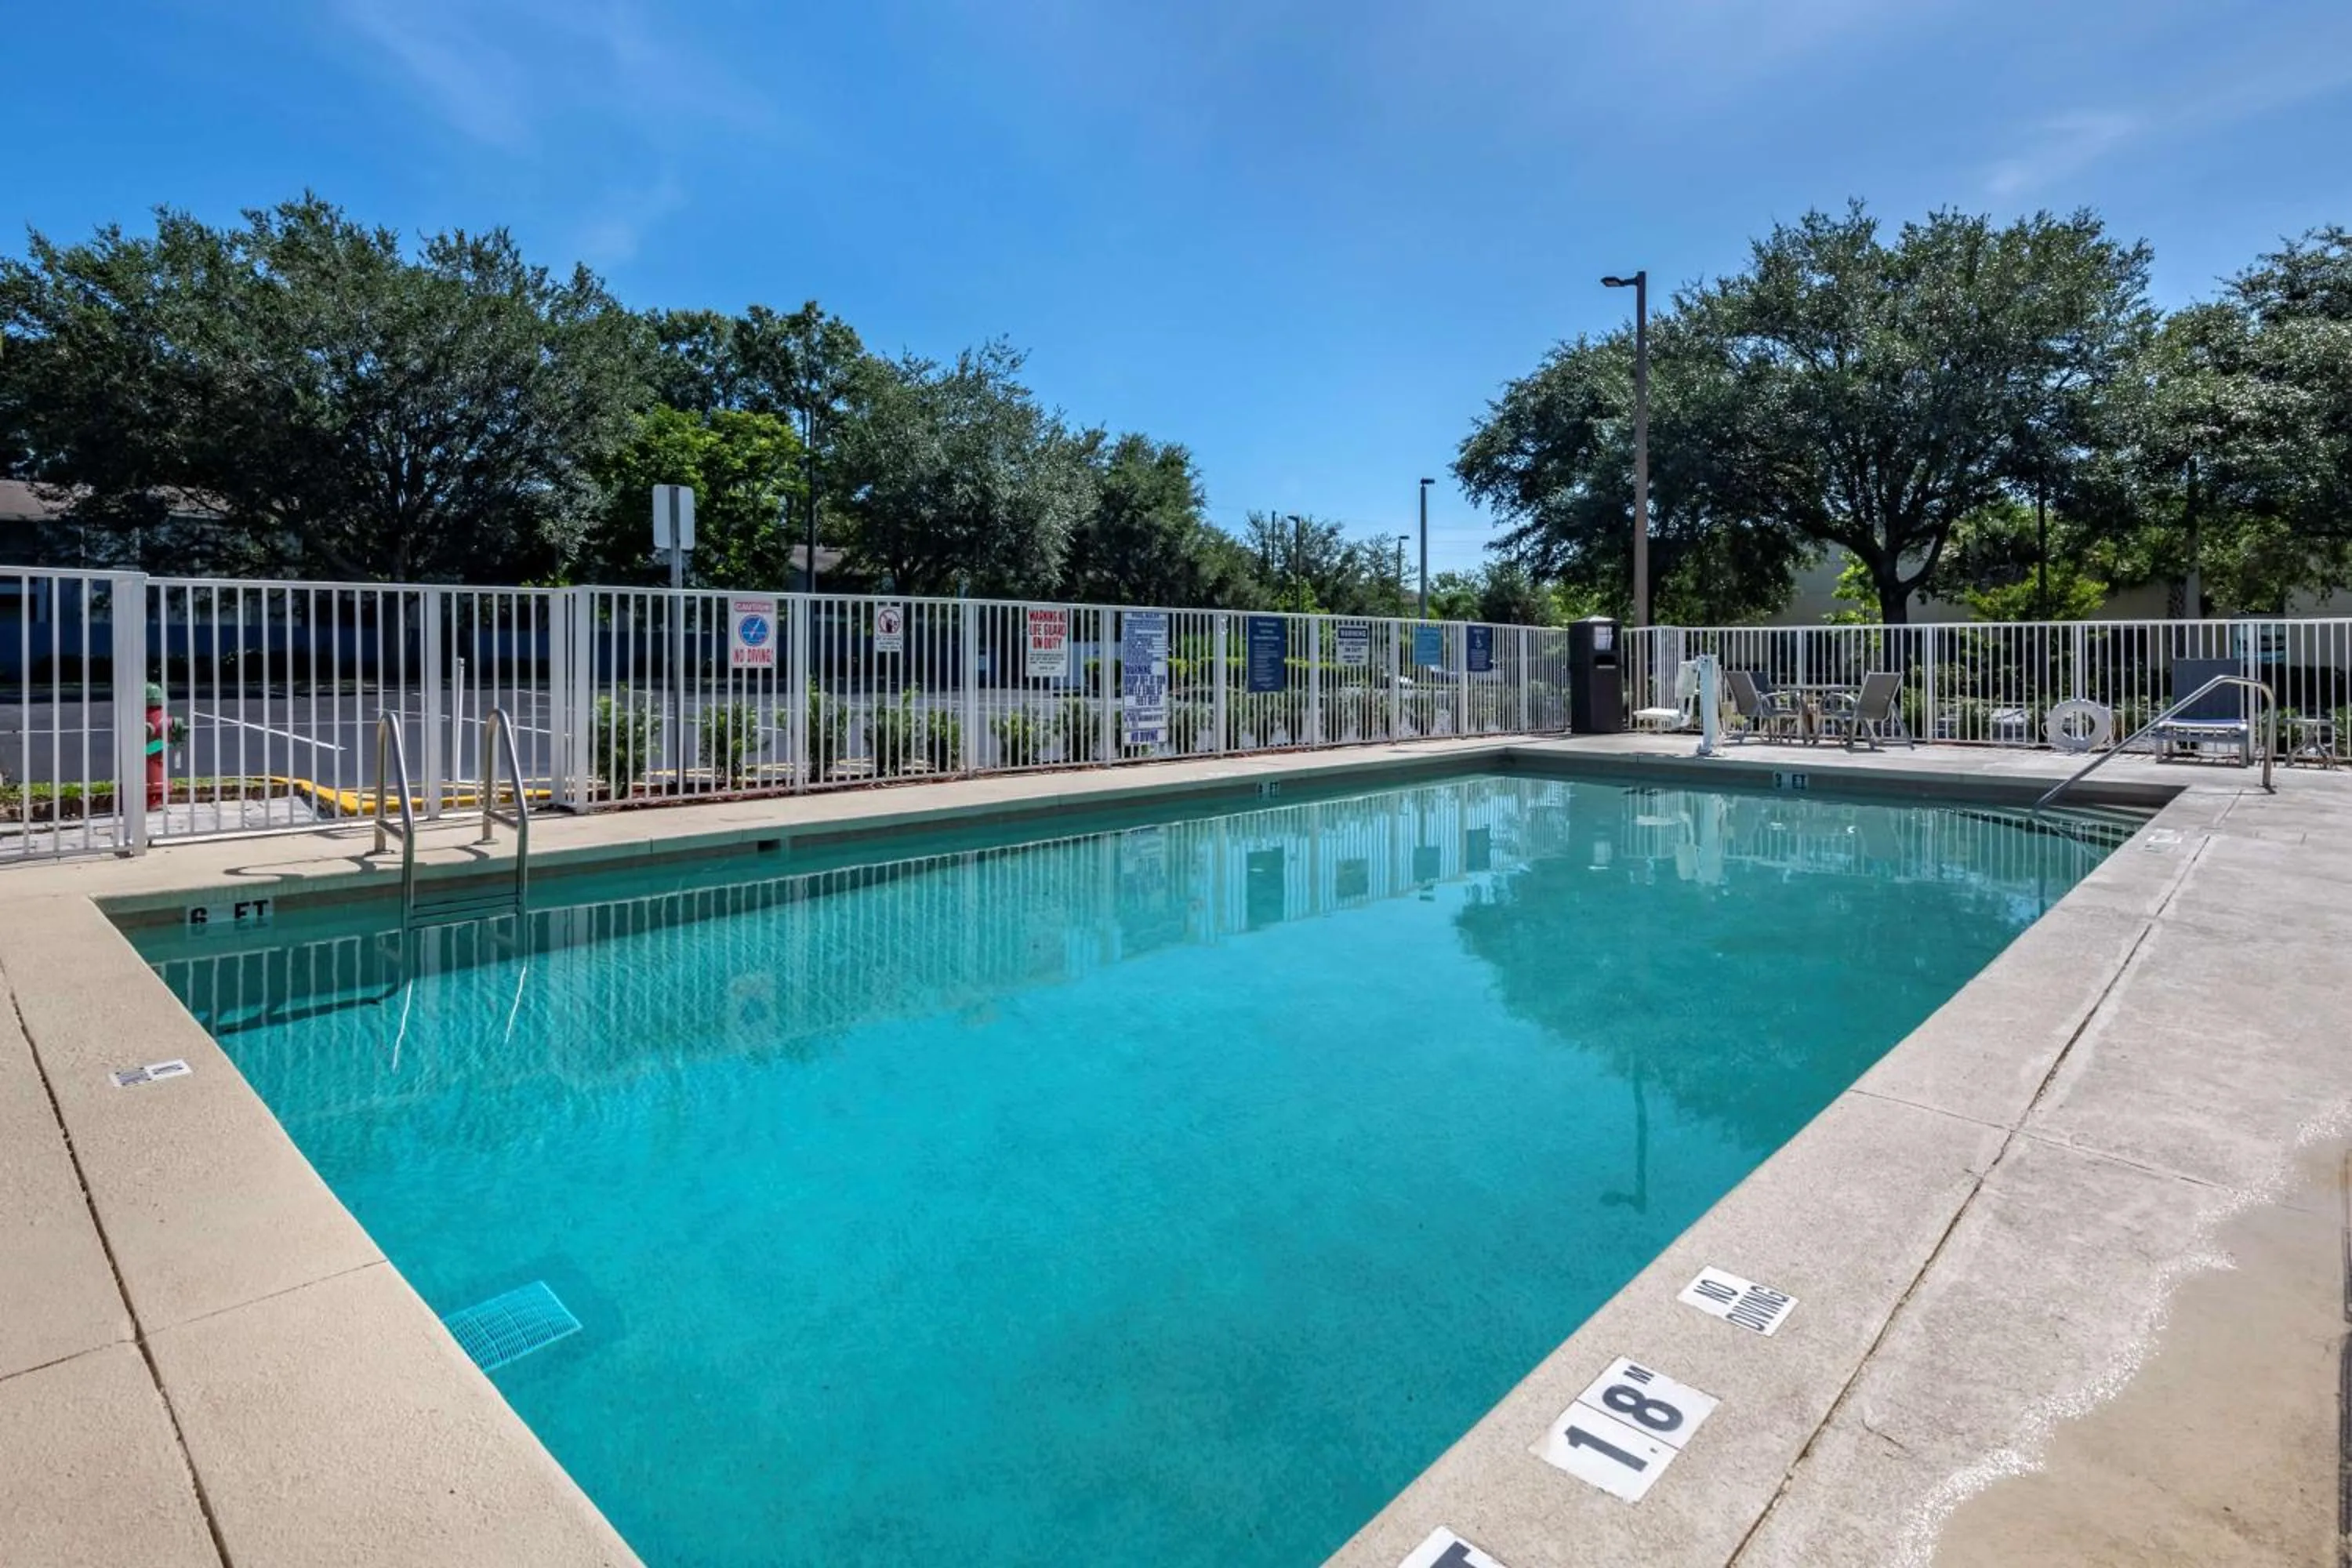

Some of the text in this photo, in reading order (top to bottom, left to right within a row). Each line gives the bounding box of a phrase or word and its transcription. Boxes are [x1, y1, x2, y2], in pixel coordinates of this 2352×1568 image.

[1029, 610, 1057, 622] WARNING
[1033, 637, 1062, 649] ON DUTY
[733, 648, 744, 662] NO
[234, 900, 269, 920] FT
[1693, 1279, 1738, 1305] NO
[1726, 1285, 1790, 1331] DIVING
